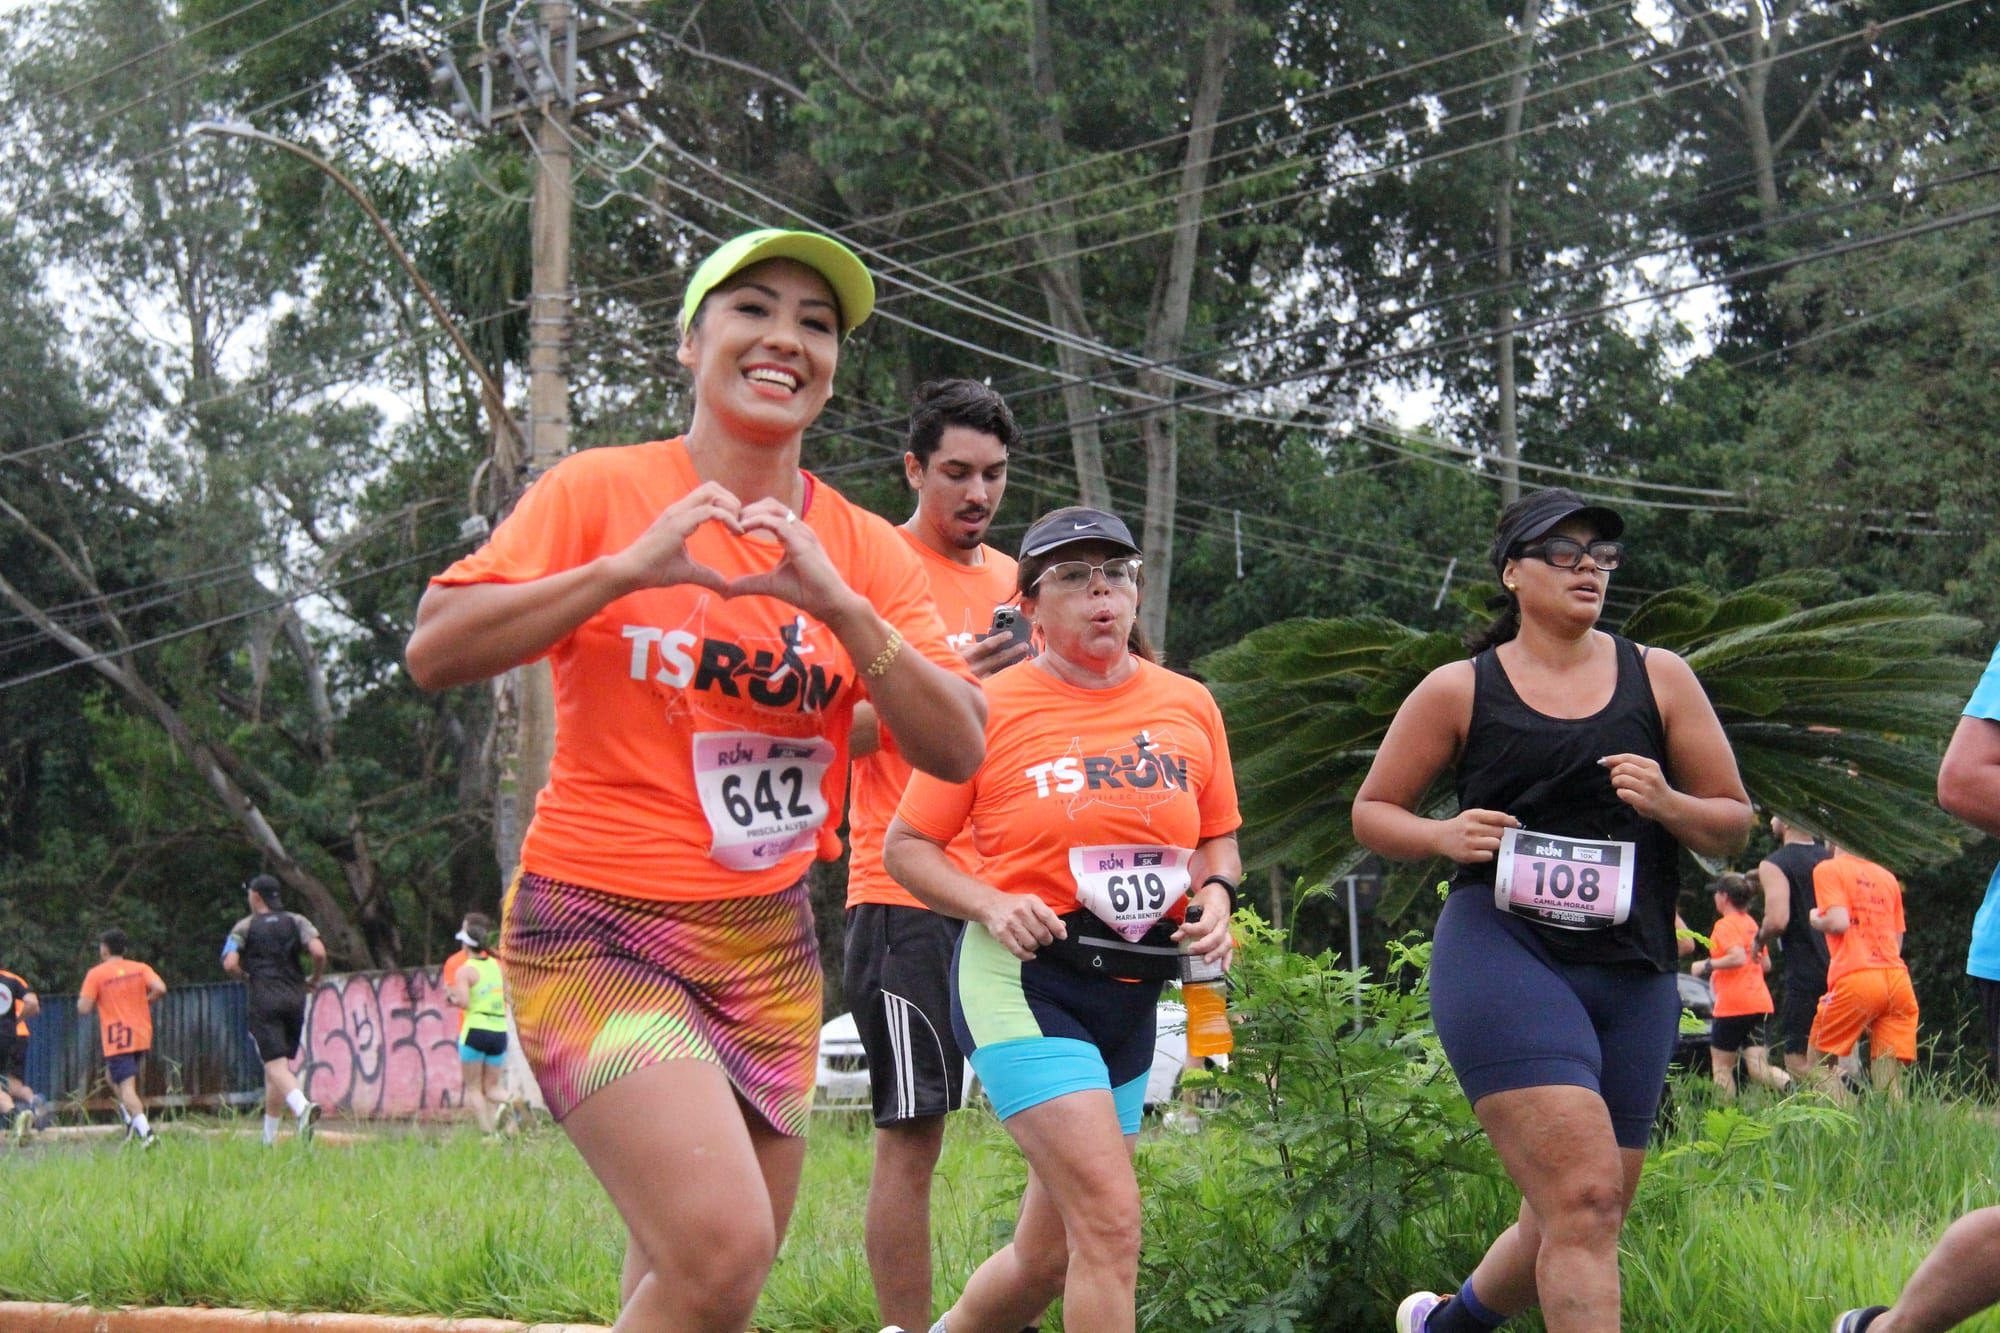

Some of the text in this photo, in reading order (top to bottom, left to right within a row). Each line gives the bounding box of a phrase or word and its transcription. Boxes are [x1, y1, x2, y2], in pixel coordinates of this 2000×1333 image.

[718, 745, 753, 766] RUN
[722, 766, 813, 827] 642
[746, 825, 783, 838] PRISCILA
[1536, 843, 1562, 857] RUN
[1099, 856, 1124, 871] RUN
[1142, 858, 1153, 866] 5K
[1532, 861, 1600, 902] 108
[1108, 873, 1166, 913] 619
[1534, 897, 1595, 911] CAMILA MORAES
